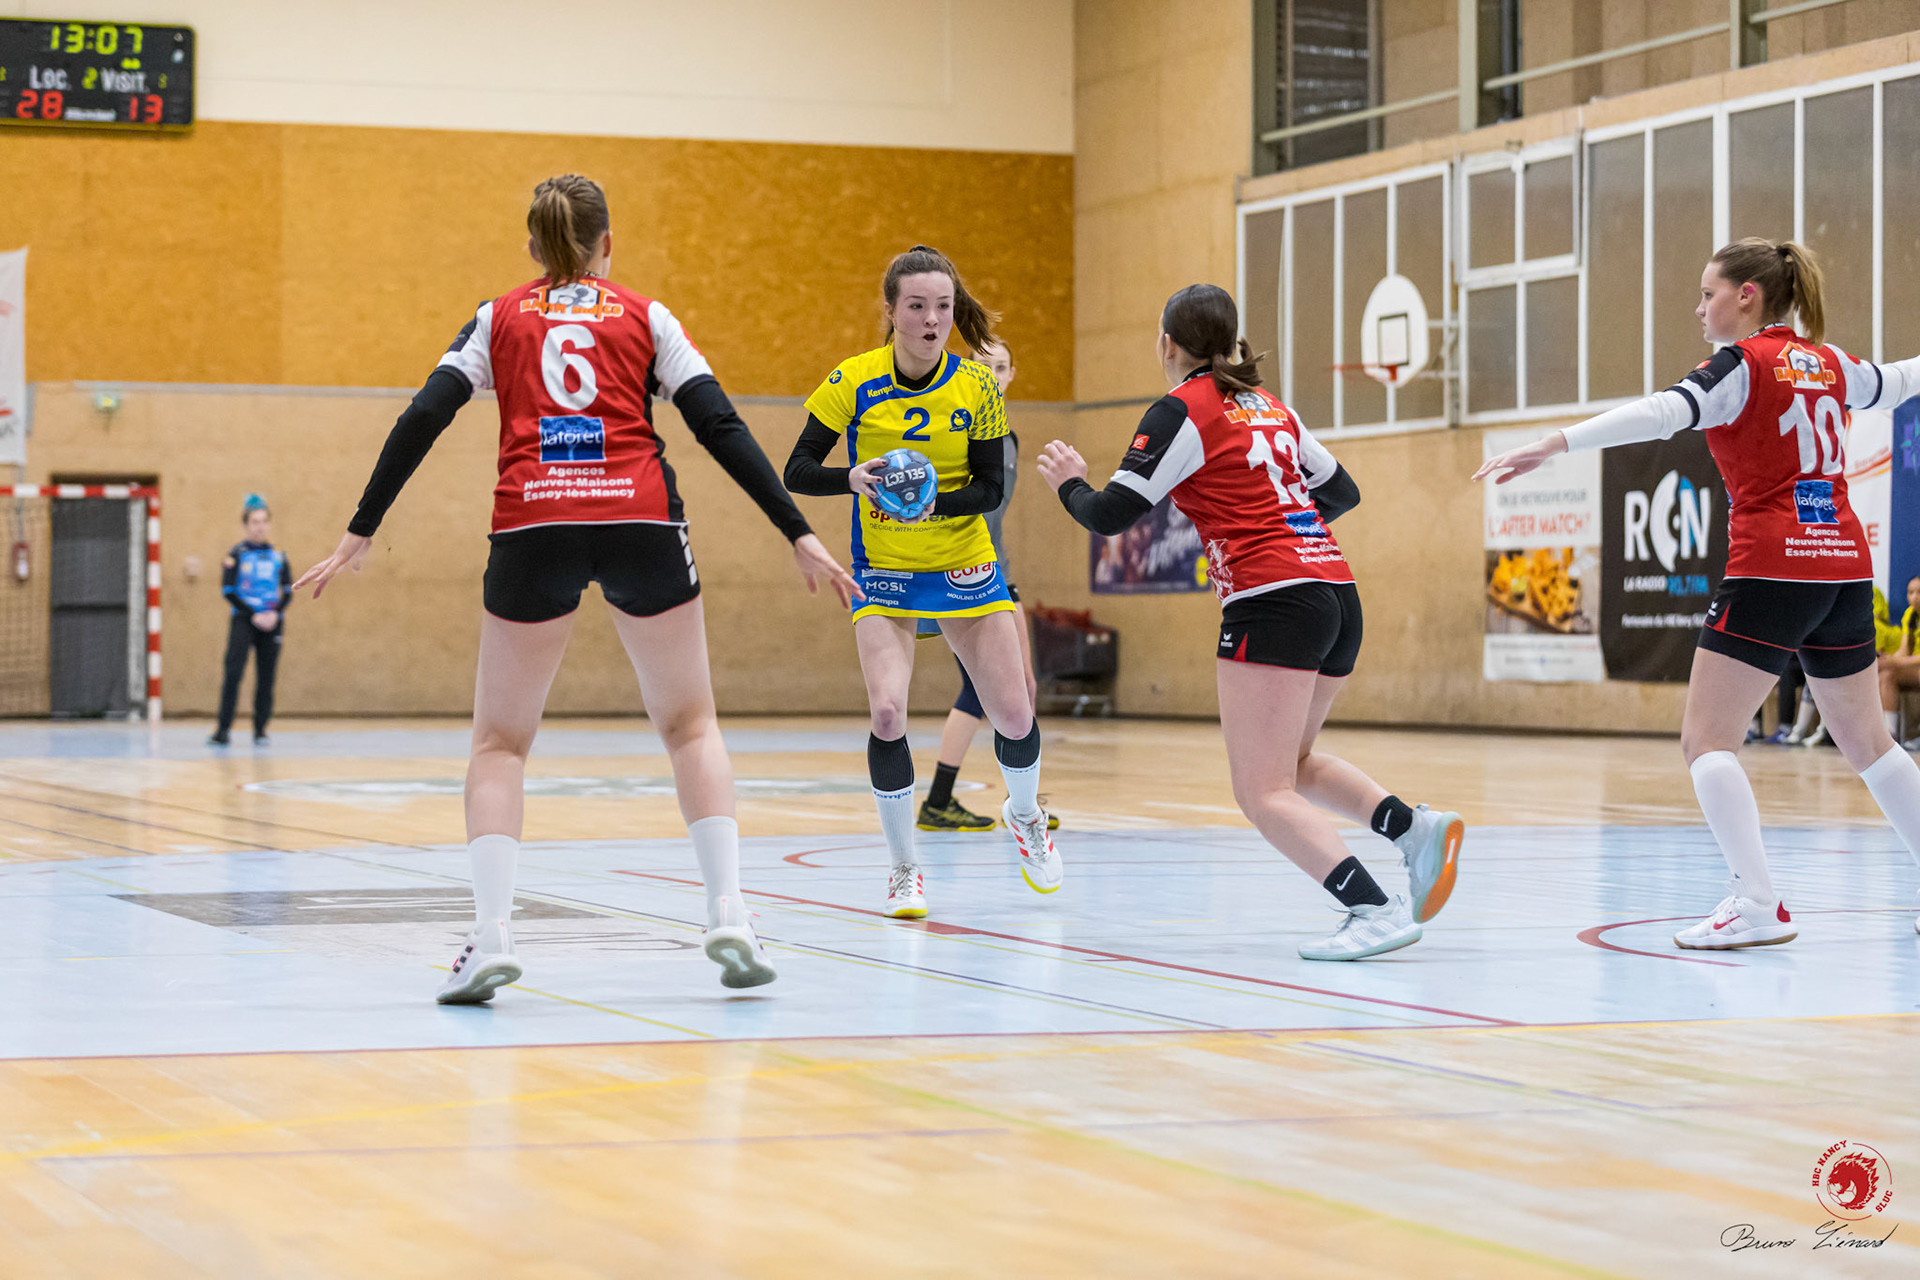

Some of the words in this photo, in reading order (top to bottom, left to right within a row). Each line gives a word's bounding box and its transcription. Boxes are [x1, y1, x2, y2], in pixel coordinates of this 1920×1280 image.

[50, 24, 143, 54] 13:07
[16, 89, 64, 120] 28
[129, 93, 164, 124] 13
[541, 323, 599, 411] 6
[867, 384, 894, 398] Kempa
[902, 407, 931, 442] 2
[1778, 392, 1845, 476] 10
[547, 466, 606, 477] Agences
[885, 467, 926, 488] SELECT
[1246, 430, 1312, 508] 13
[524, 477, 633, 491] Neuves-Maisons
[523, 488, 635, 502] Essey-lès-Nancy
[1805, 527, 1840, 537] Agences
[1785, 537, 1856, 546] Neuves-Maisons
[950, 561, 992, 579] cora
[865, 581, 906, 593] MOSL
[946, 592, 974, 601] MOULINS
[975, 592, 987, 600] LES
[987, 583, 1001, 596] METZ
[868, 596, 899, 606] Kempa
